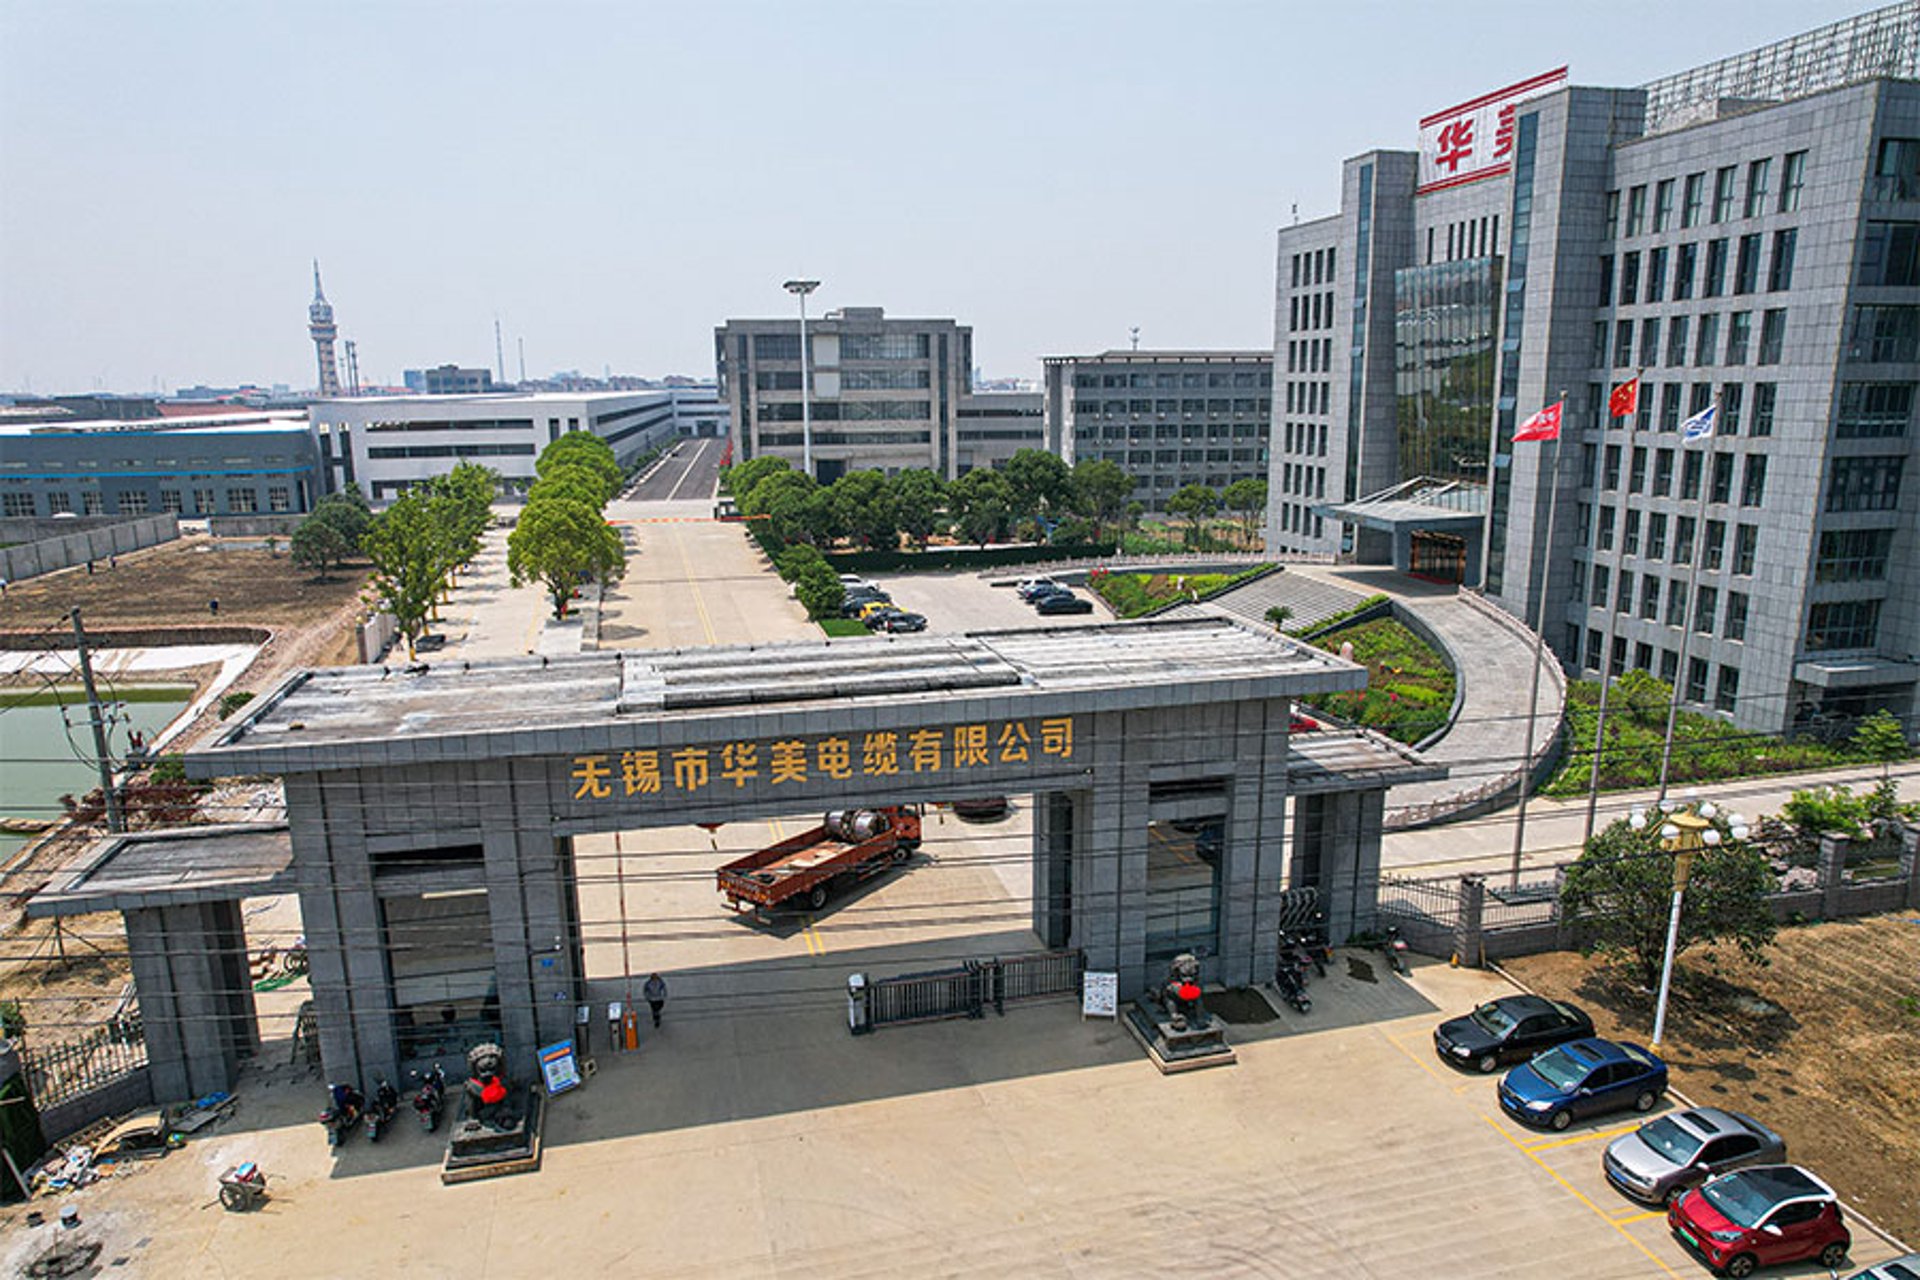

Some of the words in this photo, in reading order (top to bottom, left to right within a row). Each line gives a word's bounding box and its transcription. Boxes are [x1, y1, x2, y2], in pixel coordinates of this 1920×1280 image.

[572, 718, 1073, 799] 无锡市华美电缆有限公司
